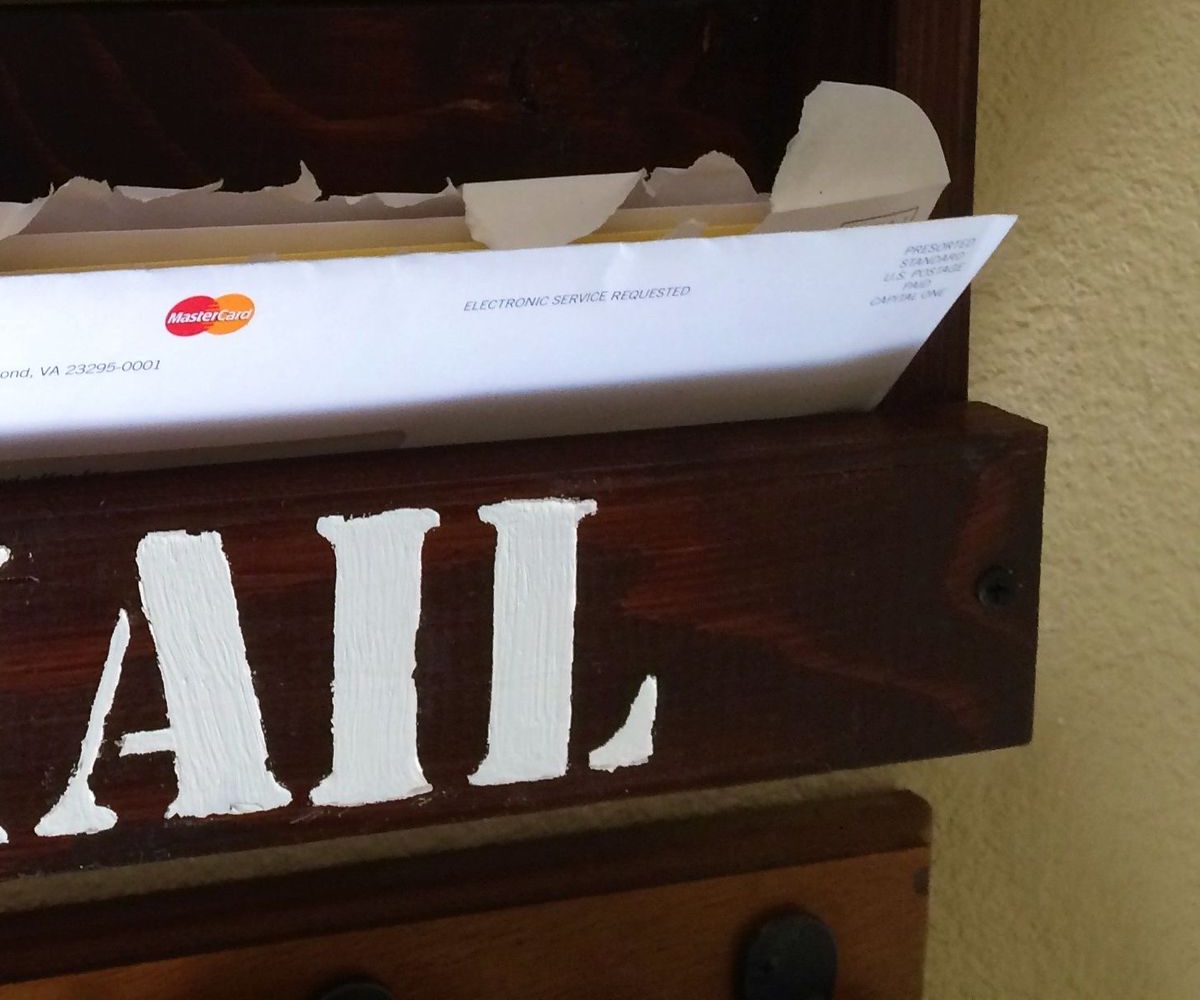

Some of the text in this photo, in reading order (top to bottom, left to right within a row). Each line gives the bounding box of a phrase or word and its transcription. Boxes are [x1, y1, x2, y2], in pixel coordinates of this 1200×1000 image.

[904, 237, 977, 255] PRESORTED
[911, 262, 967, 279] POSTAGE
[463, 286, 692, 312] ELECTRONIC SERVICE REQUESTED
[166, 308, 254, 325] MasterCard
[40, 364, 61, 377] VA
[64, 359, 162, 376] 23295-0001
